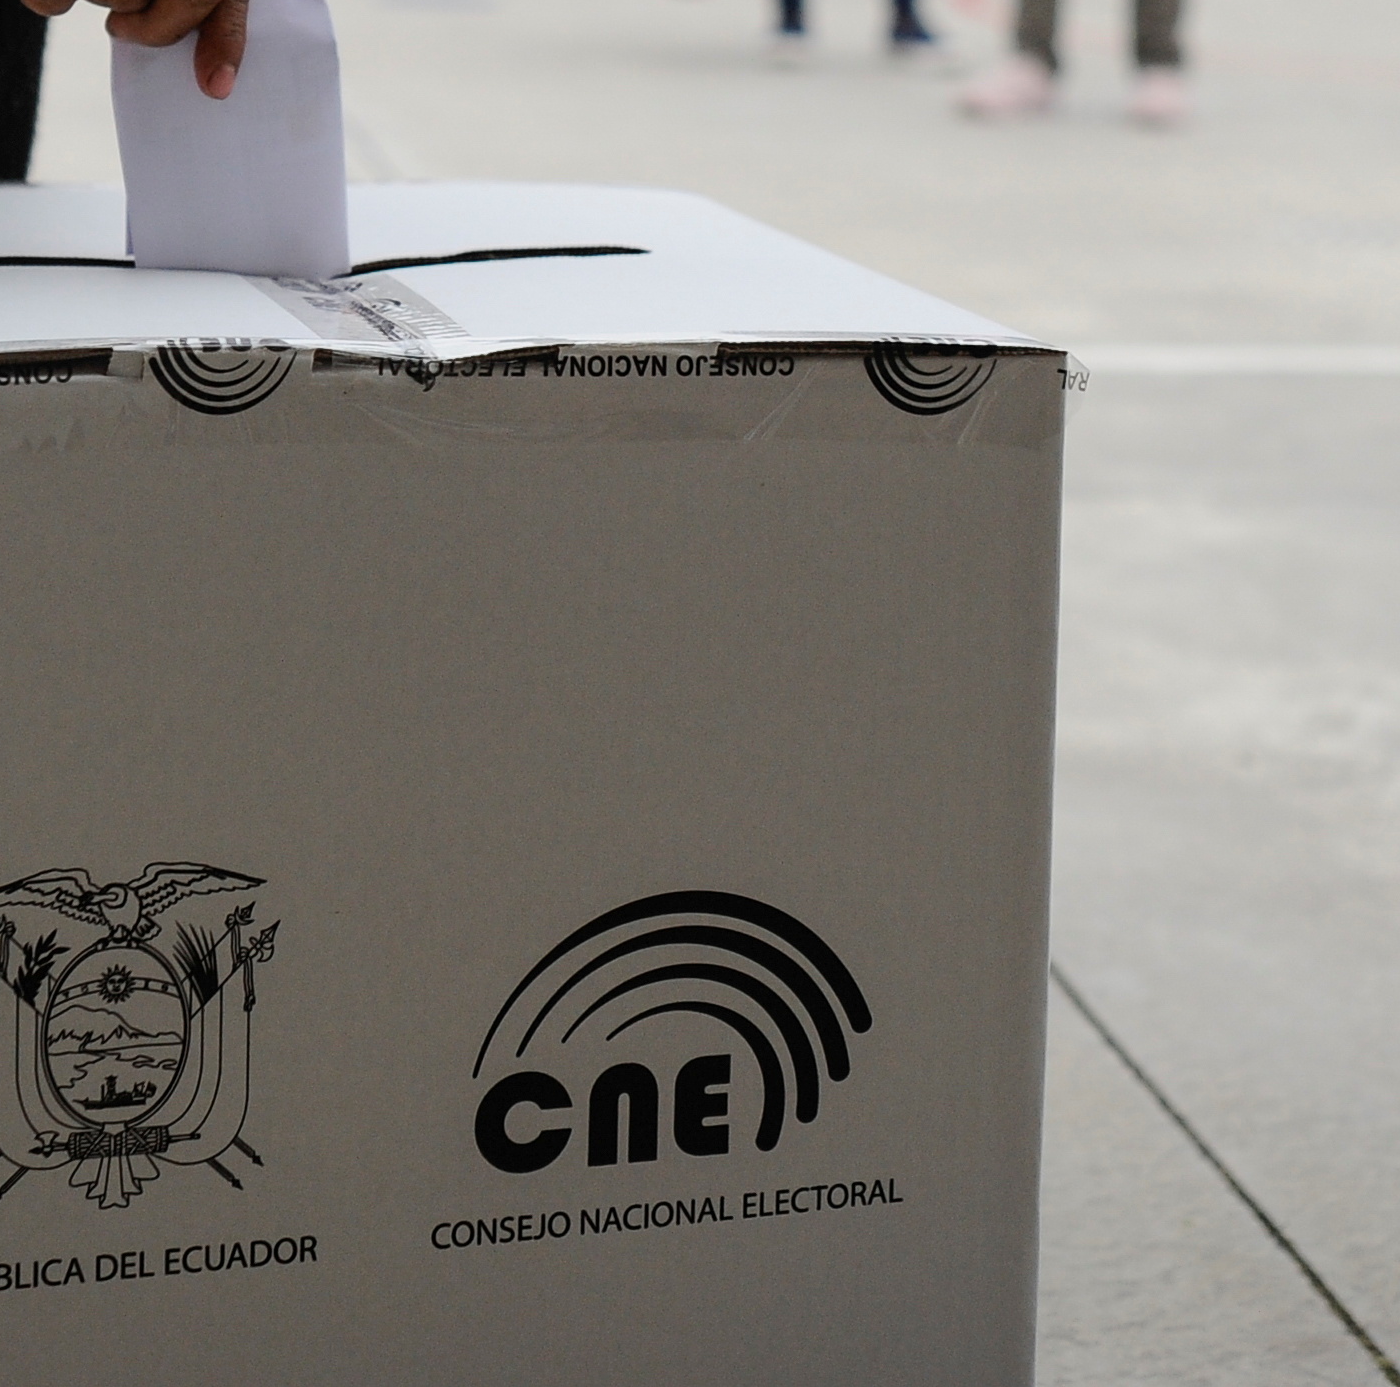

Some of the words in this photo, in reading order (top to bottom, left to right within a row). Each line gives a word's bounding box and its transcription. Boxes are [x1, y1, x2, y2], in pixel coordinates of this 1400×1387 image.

[370, 356, 529, 378] ELECTORAL
[538, 355, 667, 378] NACIONAL
[676, 355, 796, 378] CONSEJO
[431, 1212, 571, 1250] CONSEJO
[579, 1195, 734, 1236] NACIONAL
[742, 1178, 904, 1219] ELECTORAL
[95, 1251, 155, 1282] DEL
[163, 1235, 318, 1275] ECUADOR
